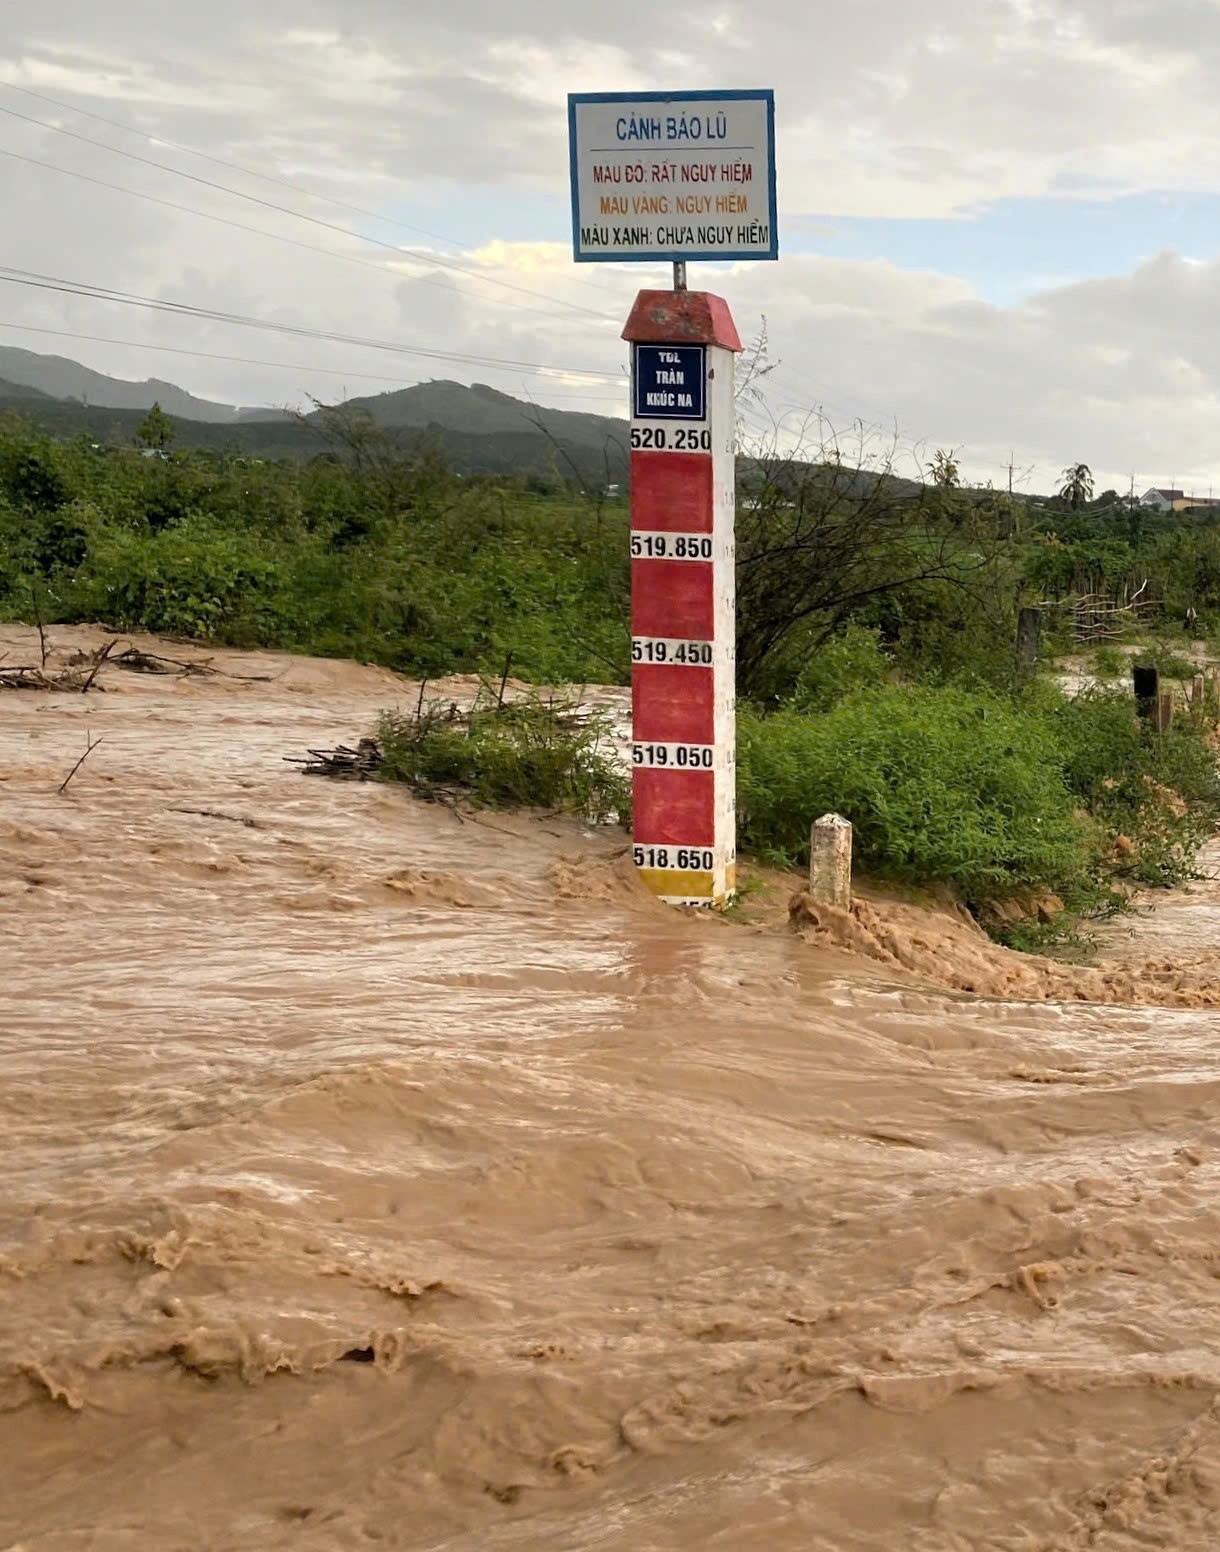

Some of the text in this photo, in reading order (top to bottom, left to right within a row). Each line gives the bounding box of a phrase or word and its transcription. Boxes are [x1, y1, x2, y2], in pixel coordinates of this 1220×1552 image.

[667, 111, 702, 139] BÁO
[707, 111, 727, 139] LŨ
[681, 164, 717, 183] NGUY
[677, 195, 712, 214] NGUY
[581, 219, 769, 245] MÀU XANH: CHƯA NGUY HIỂM
[656, 368, 684, 385] TRÀN
[647, 390, 693, 407] KHÚC NA
[630, 428, 711, 450] 520.250
[631, 535, 713, 559] 519.850
[631, 639, 713, 664] 519.450
[632, 743, 713, 768] 519.050
[633, 847, 714, 871] 518.650
